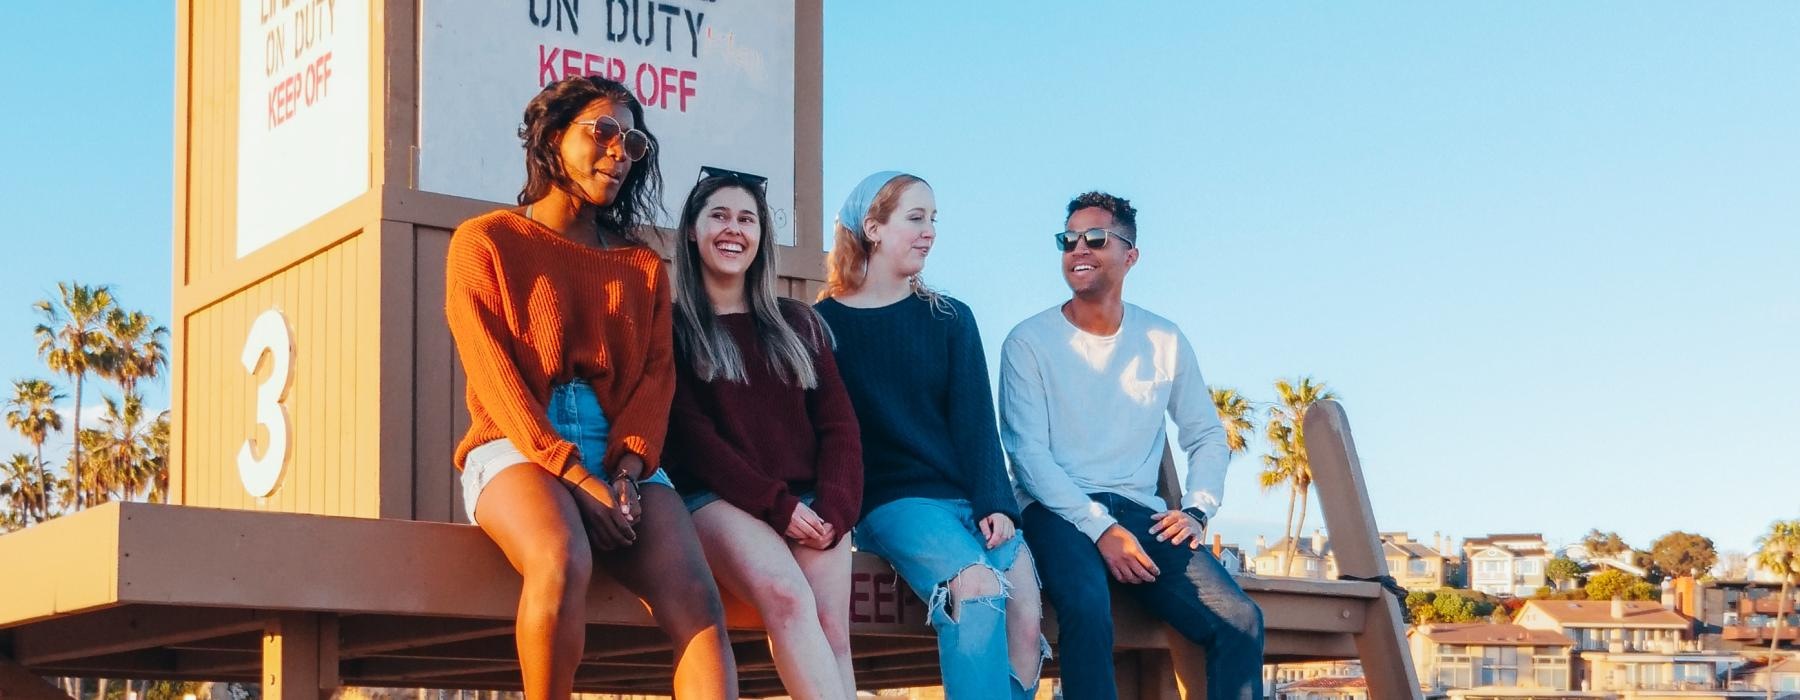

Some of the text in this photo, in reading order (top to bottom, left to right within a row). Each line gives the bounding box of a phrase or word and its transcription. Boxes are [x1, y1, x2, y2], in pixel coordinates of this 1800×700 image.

[265, 23, 286, 77] ON
[294, 0, 336, 58] DUTY
[528, 0, 705, 58] ON DUTY
[267, 52, 332, 131] KEEP OFF
[539, 44, 697, 112] KEEP OFF
[236, 308, 292, 498] 3
